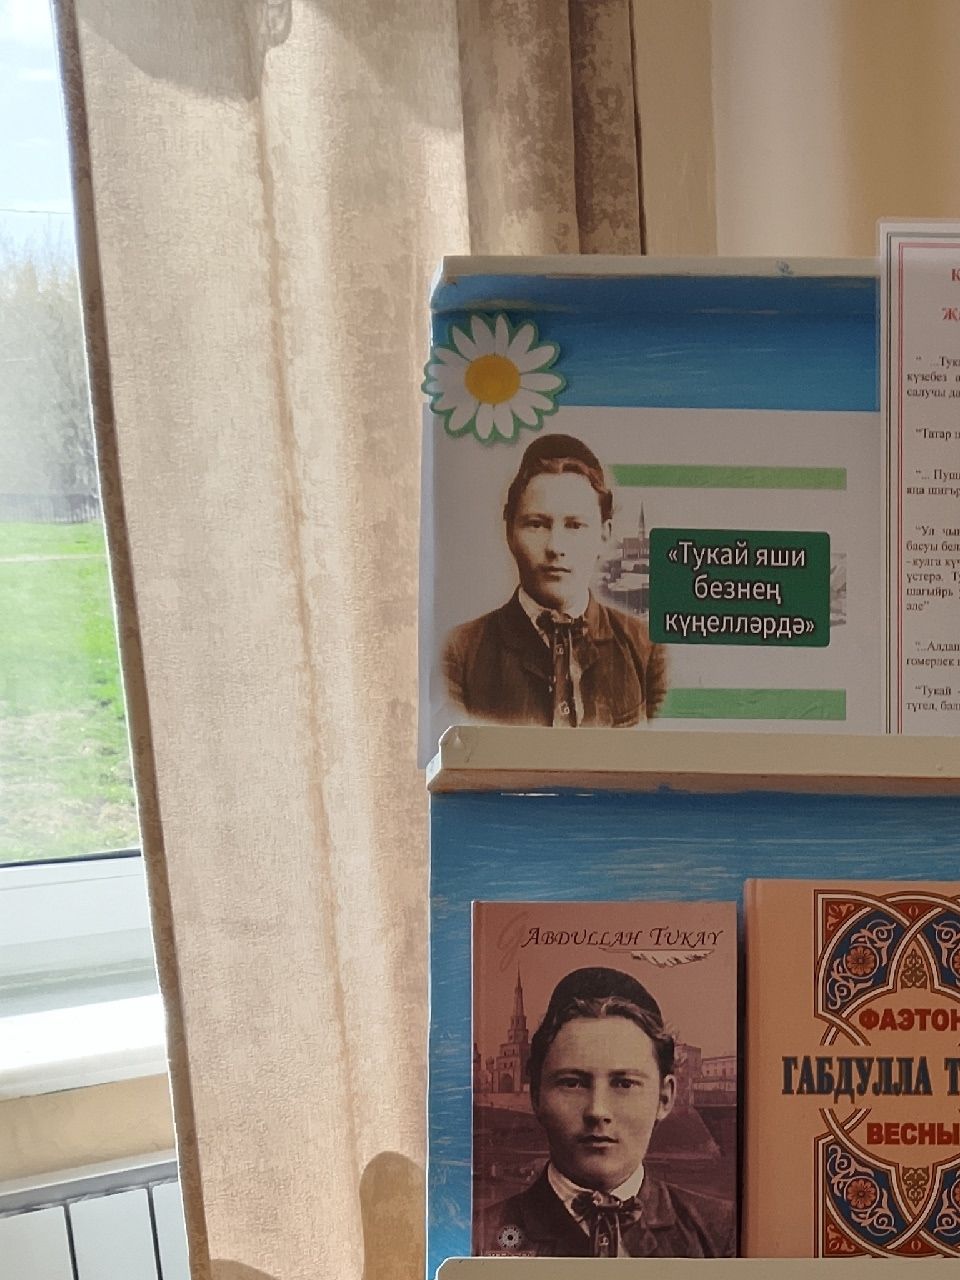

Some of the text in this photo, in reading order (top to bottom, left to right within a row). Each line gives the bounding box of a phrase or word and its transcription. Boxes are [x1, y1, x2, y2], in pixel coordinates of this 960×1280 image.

[668, 541, 806, 571] «Тукай яши
[694, 574, 782, 605] безнең
[665, 612, 815, 639] күңелләрдә»
[781, 1055, 932, 1104] ГАБДУЛЛА
[866, 1122, 960, 1145] ВЕСНЫ
